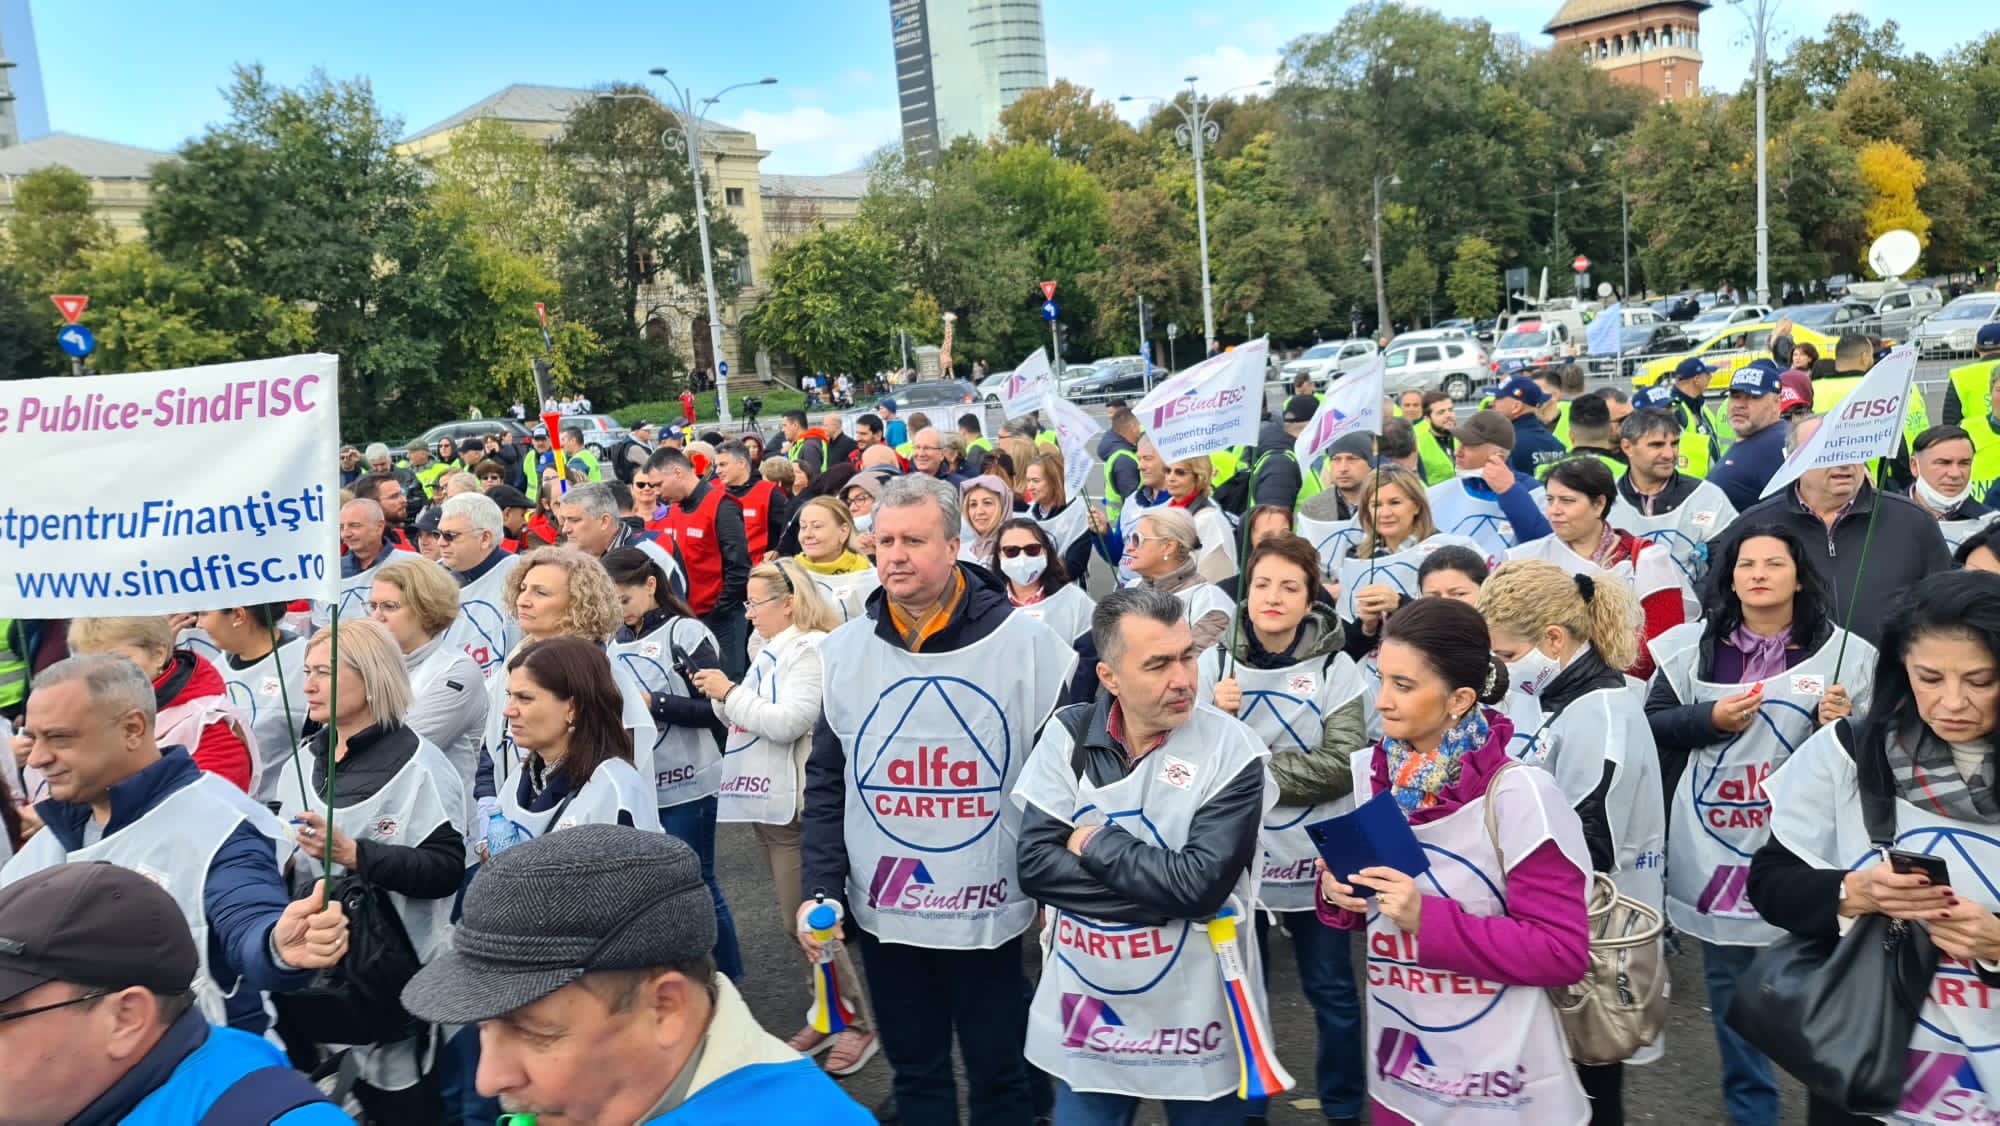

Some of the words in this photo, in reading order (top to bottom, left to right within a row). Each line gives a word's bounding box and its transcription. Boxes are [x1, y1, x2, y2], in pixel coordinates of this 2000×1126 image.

[16, 374, 320, 433] Publice-SindFISC
[0, 484, 324, 549] tpentruFinanţişti
[16, 553, 325, 599] www.sindfisc.ro
[887, 746, 977, 787] alfa
[875, 794, 994, 818] CARTEL
[901, 878, 1007, 910] SindFISC
[1059, 919, 1174, 960] CARTEL
[1367, 965, 1497, 995] CARTEL
[1089, 1021, 1222, 1055] SindFISC
